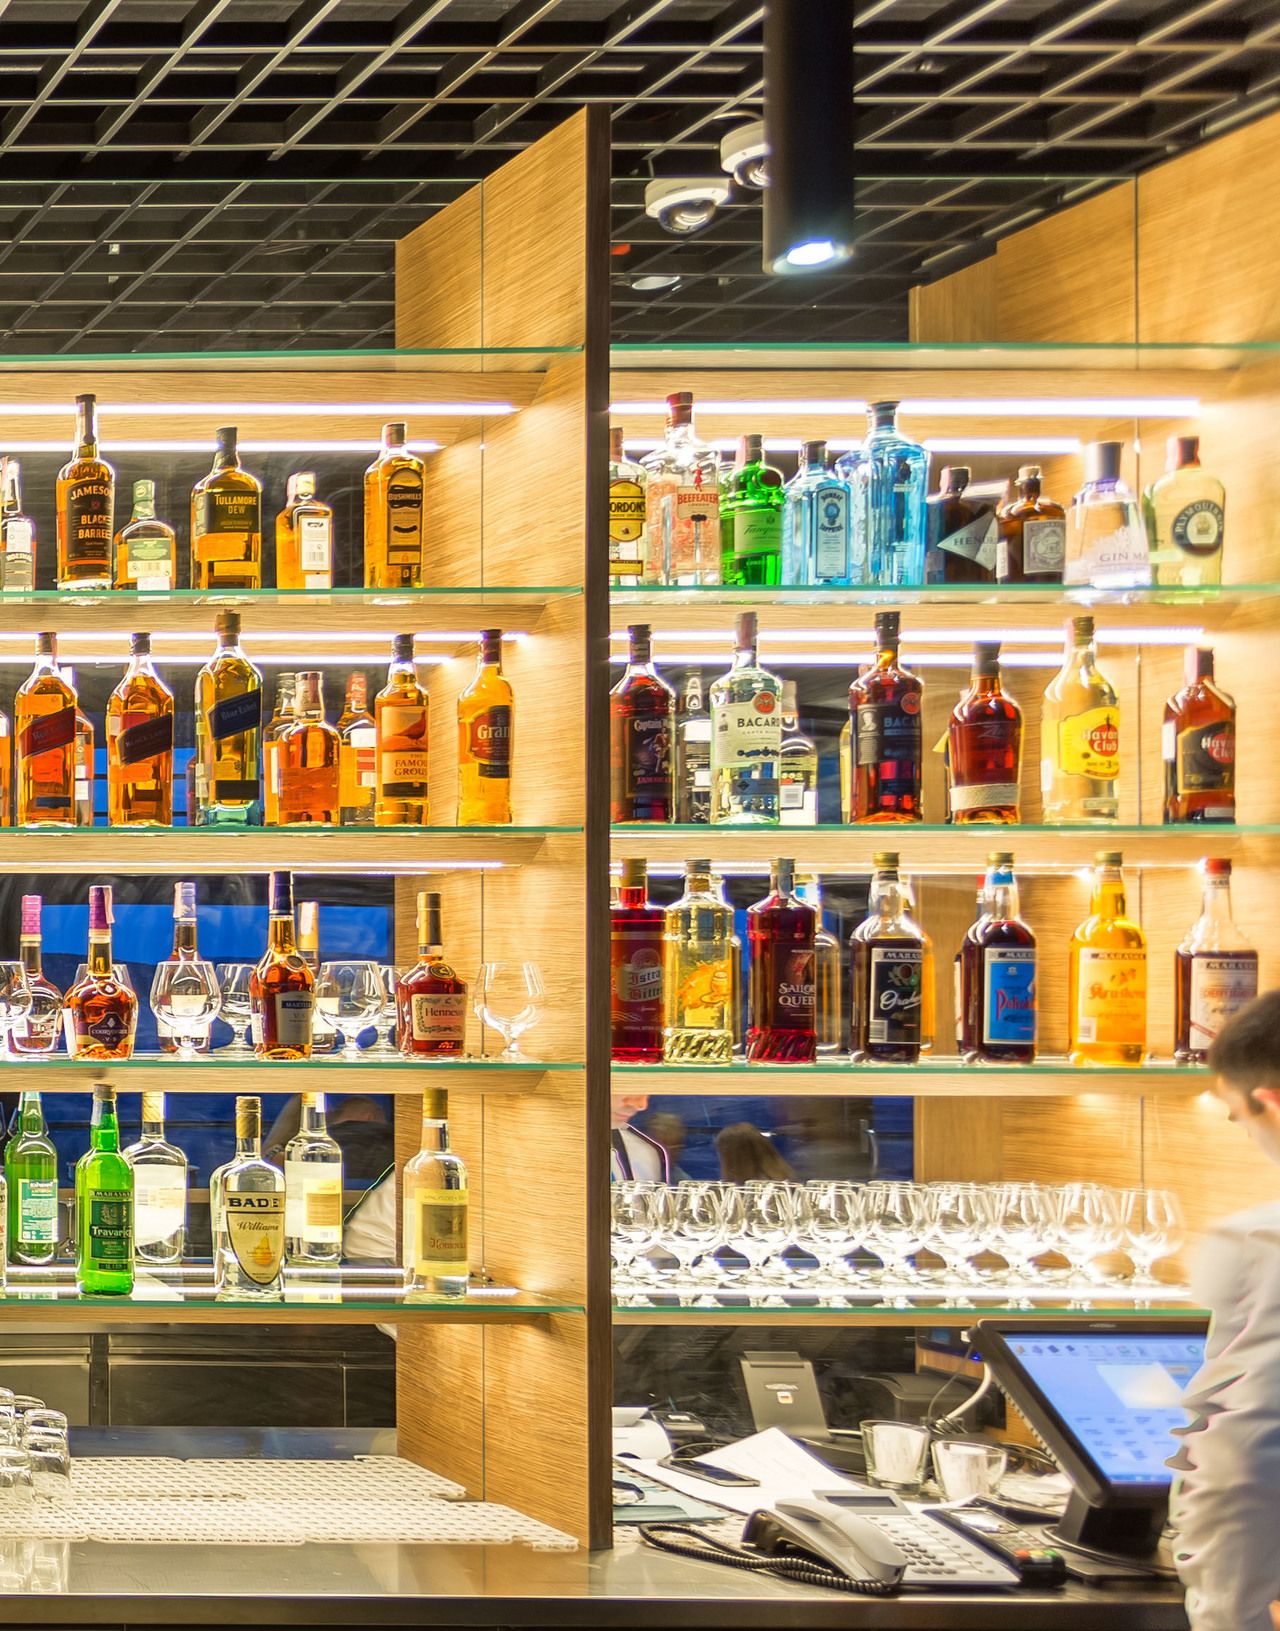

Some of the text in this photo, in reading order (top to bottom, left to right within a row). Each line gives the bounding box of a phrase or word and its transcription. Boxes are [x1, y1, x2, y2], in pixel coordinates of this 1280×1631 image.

[214, 494, 257, 507] TULLAMORE
[388, 493, 422, 501] BUSHMILLS
[677, 493, 719, 505] BEEFEATER
[228, 506, 245, 514] DEW
[1099, 551, 1129, 563] GIN
